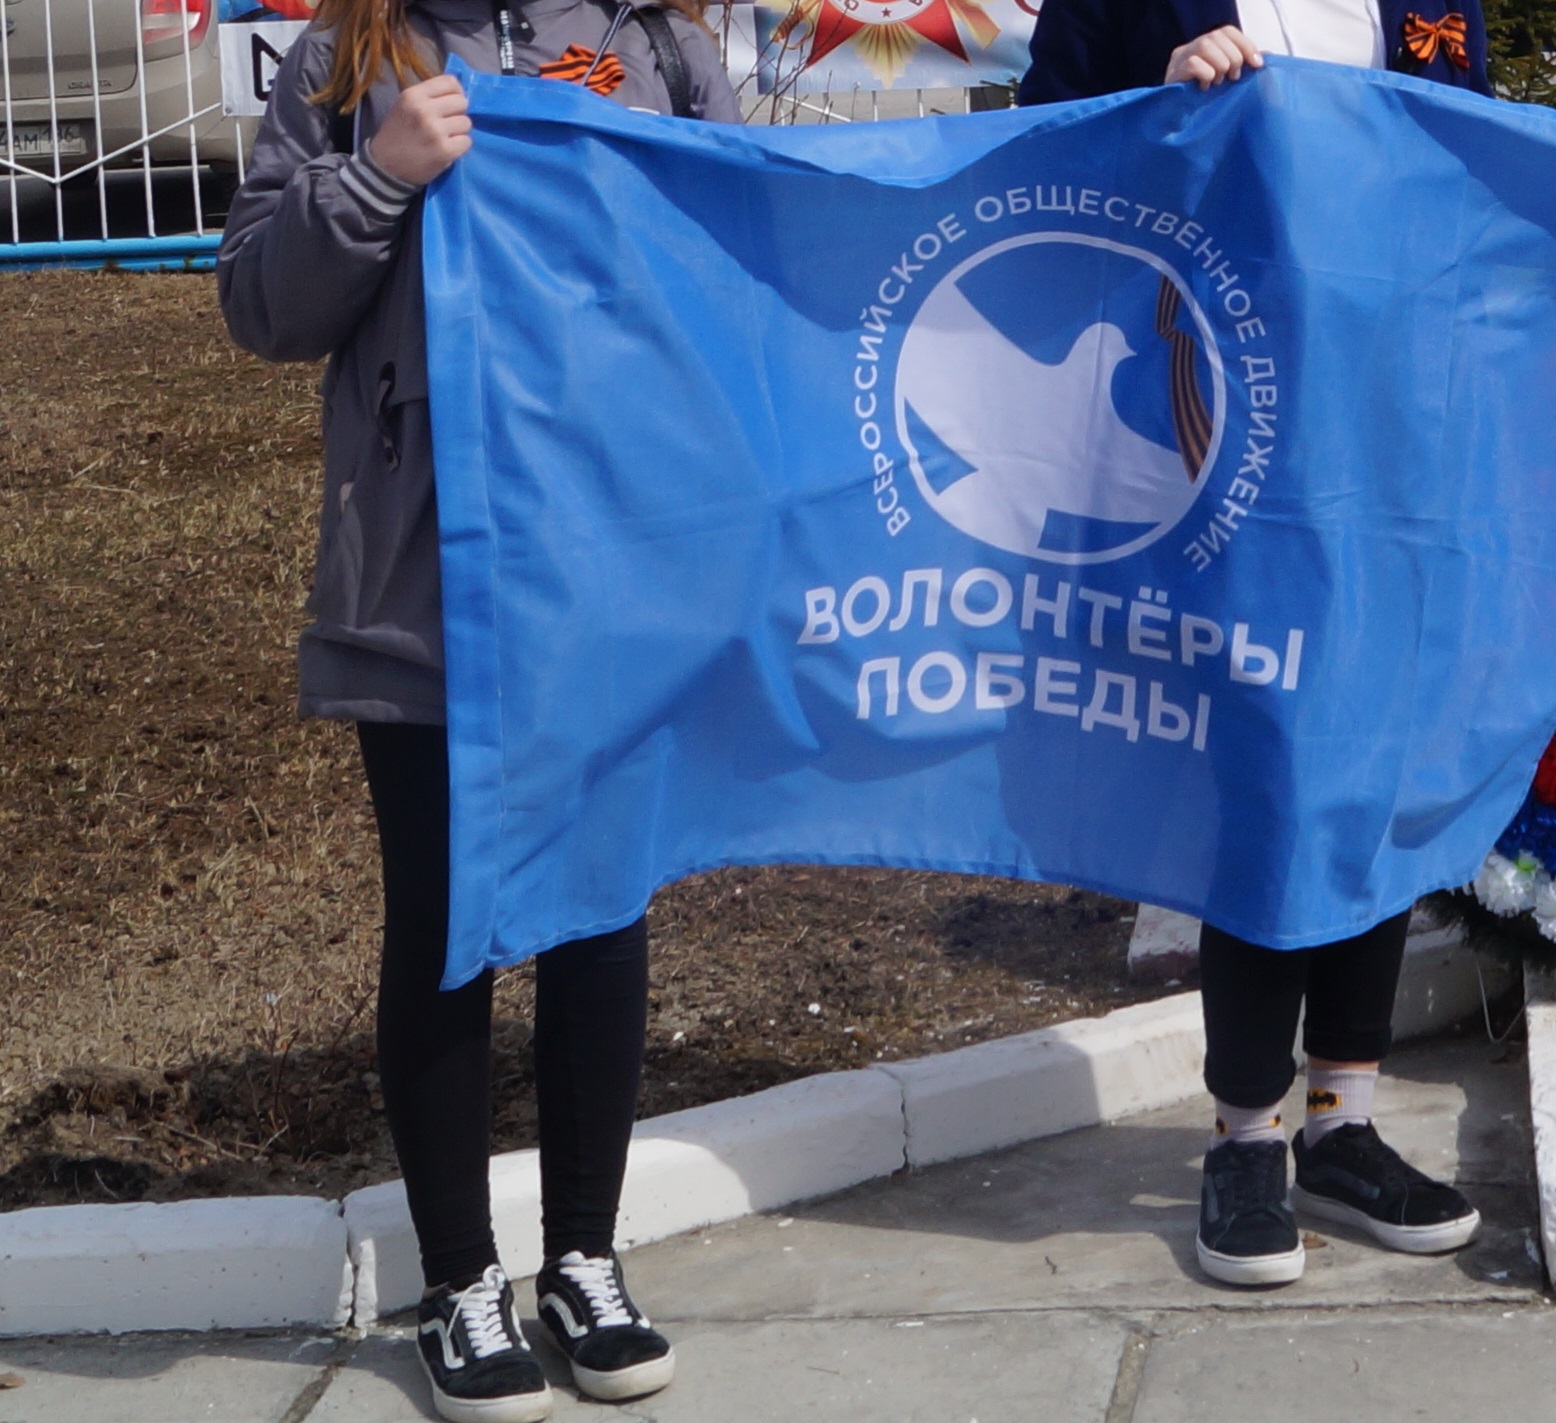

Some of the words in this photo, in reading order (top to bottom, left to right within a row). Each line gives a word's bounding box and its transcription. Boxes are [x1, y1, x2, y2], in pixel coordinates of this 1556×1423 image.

[854, 213, 967, 536] ВСЕРОССИЙСКОЕ
[975, 185, 1267, 343] ОБЩЕСТВЕННОЕ
[1183, 355, 1277, 572] ДВИЖЕНИЕ
[796, 567, 1304, 690] ВОЛОНТЁРЫ
[856, 650, 1211, 751] ПОБЕДЫ
